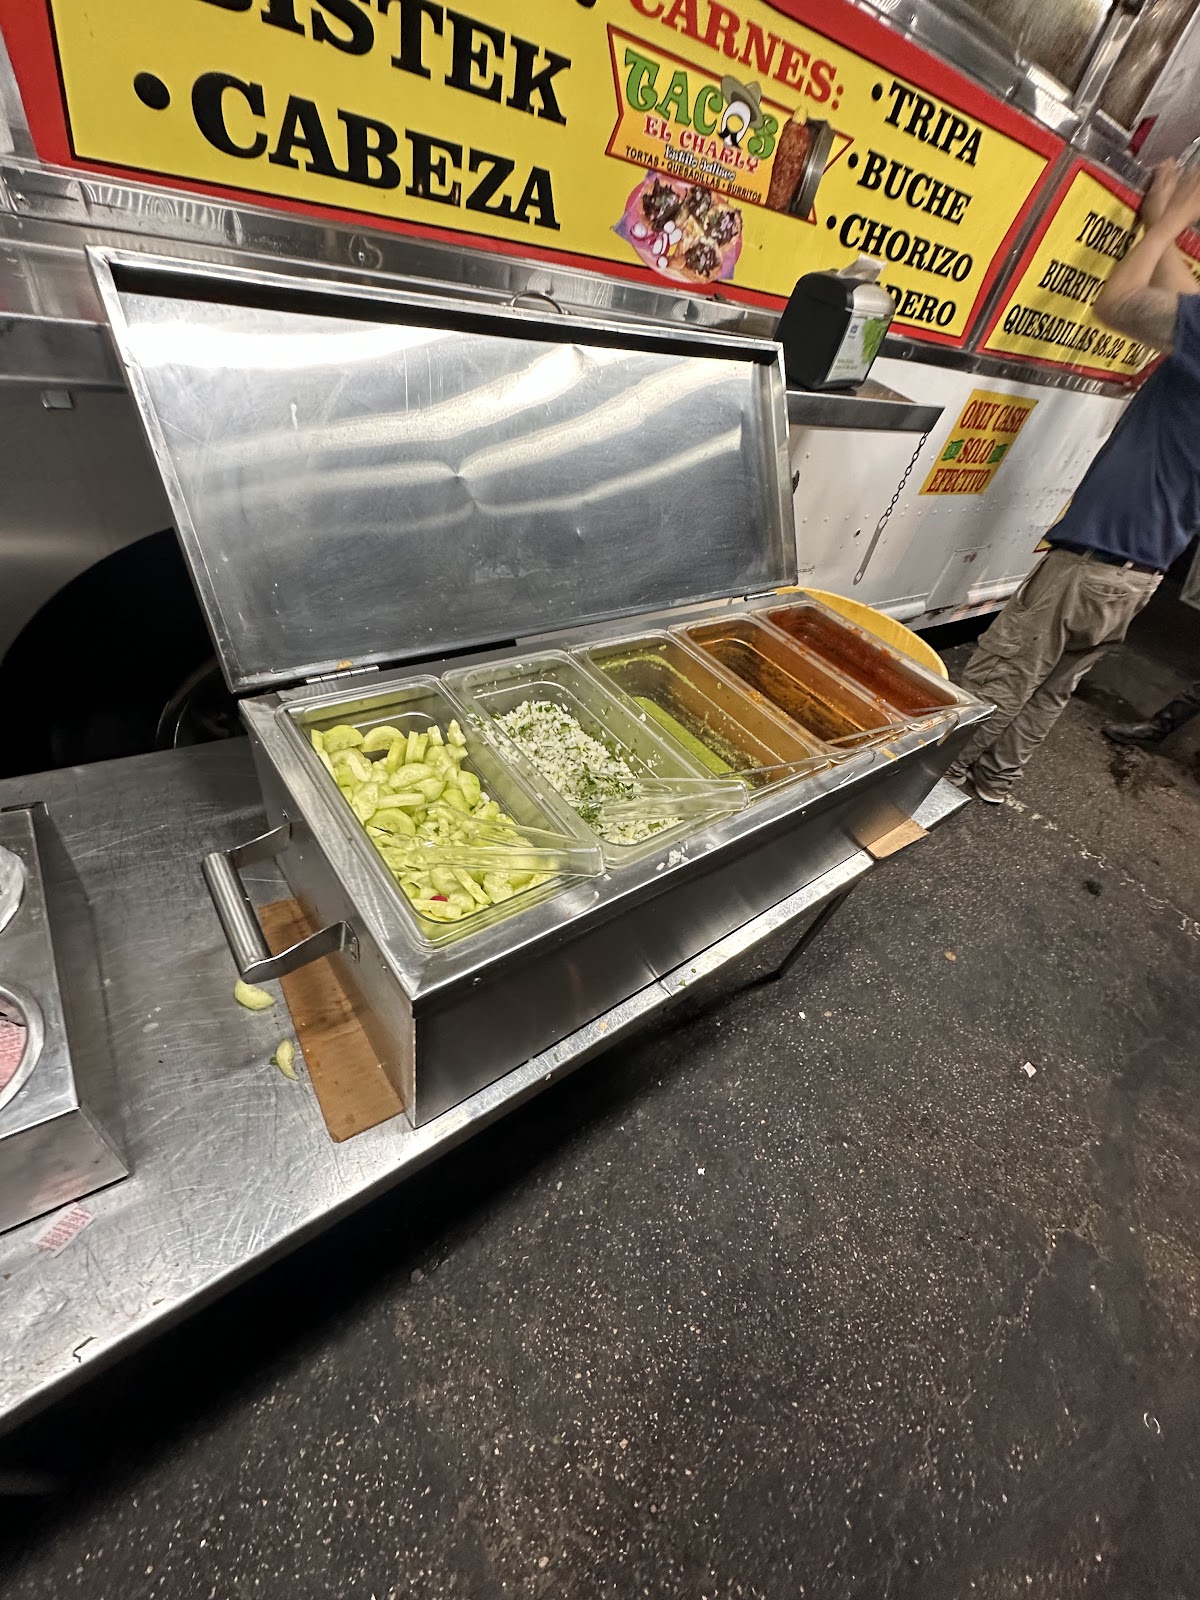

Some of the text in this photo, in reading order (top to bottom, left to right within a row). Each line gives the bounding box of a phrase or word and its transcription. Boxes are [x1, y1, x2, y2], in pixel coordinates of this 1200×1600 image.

[196, 0, 571, 126] STEK
[624, 47, 779, 160] TACOS
[885, 80, 983, 167] TRIPA
[191, 71, 561, 231] CABEZA
[625, 145, 763, 202] TORTAS QUESADILLAS BURRITOS
[644, 116, 760, 173] EL CHARLY
[857, 148, 973, 225] BUCHE
[839, 213, 974, 282] CHORIZO
[1076, 210, 1136, 262] TORTAS
[1003, 304, 1100, 353] QUESADILLAS
[960, 400, 1031, 433] ONLY CASH
[956, 437, 996, 464] SOLO
